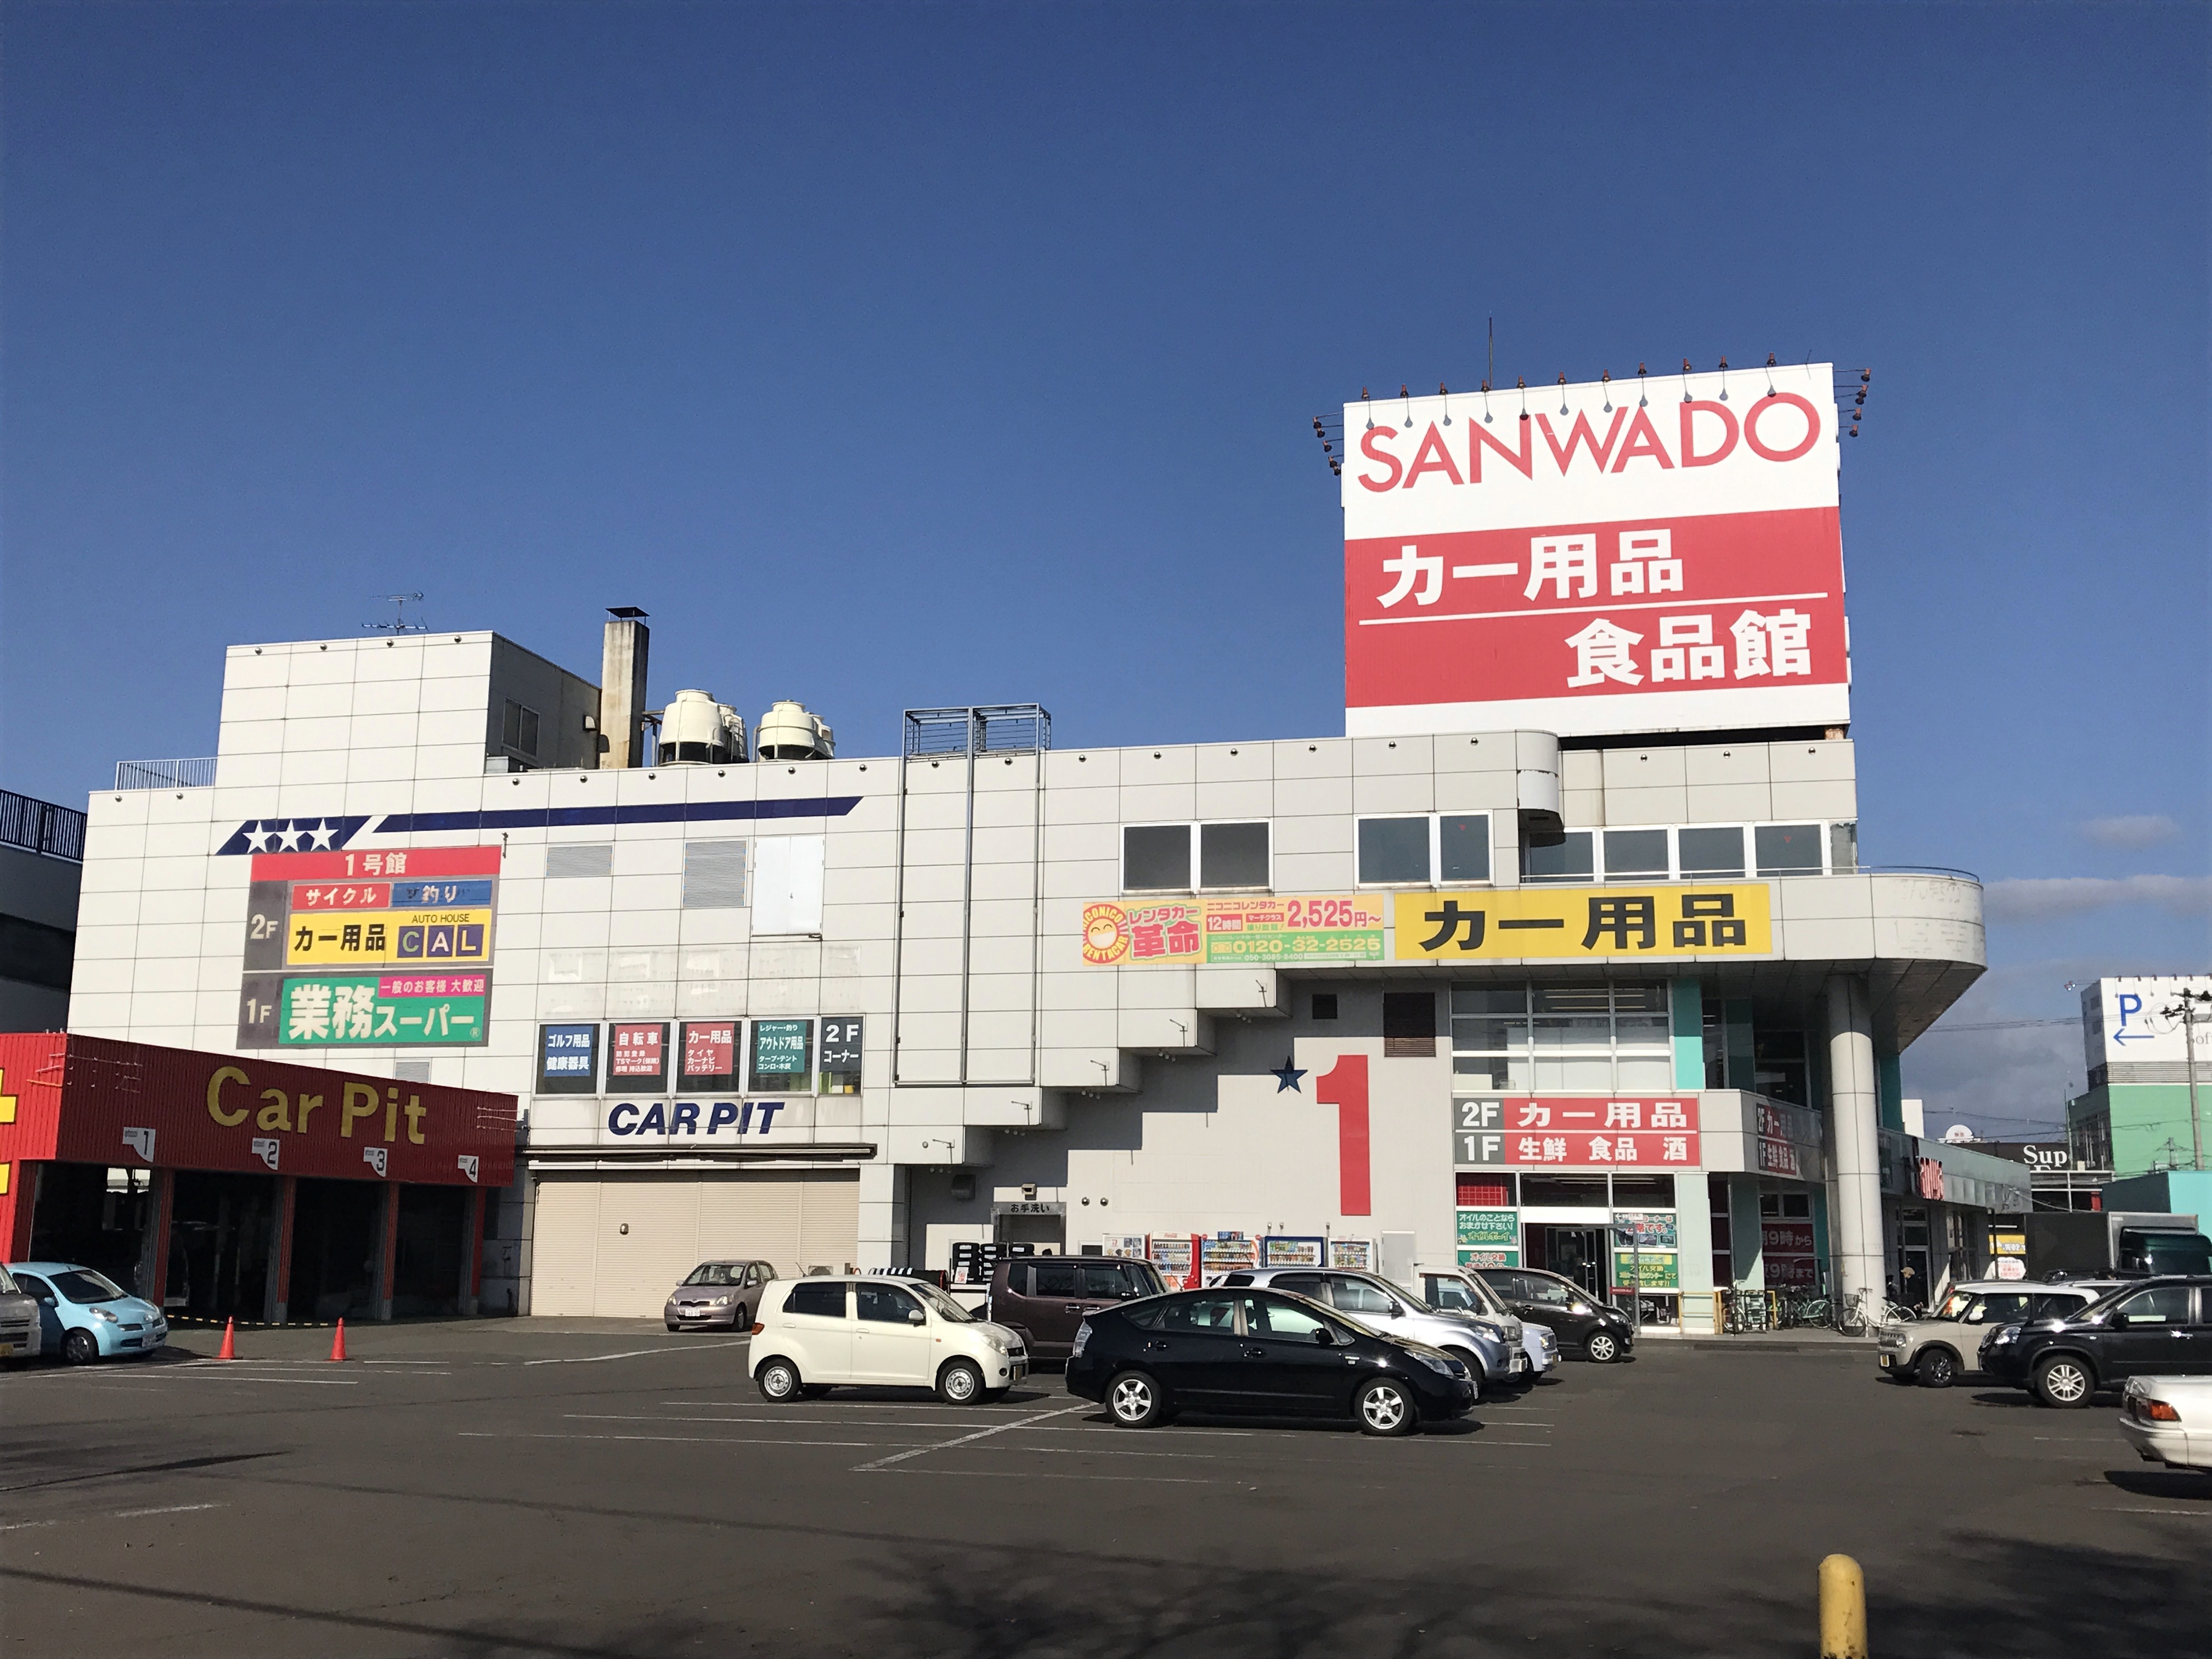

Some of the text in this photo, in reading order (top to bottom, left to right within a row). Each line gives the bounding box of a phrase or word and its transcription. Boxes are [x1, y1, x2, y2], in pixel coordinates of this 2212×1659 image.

[1357, 391, 1820, 493] SANWADO
[1376, 528, 1684, 608] カー用品
[1564, 607, 1812, 689] 食品館
[345, 852, 407, 876] 1号館
[306, 887, 377, 906] サイクル
[1207, 900, 1284, 911] ニコニコレンタカー
[411, 913, 470, 924] AUTO HOUSE
[1128, 906, 1198, 924] レンタカー
[1207, 916, 1242, 931] 12時間
[1418, 893, 1746, 952] カー用品
[250, 914, 278, 940] 2F
[294, 923, 386, 952] カー用品
[402, 929, 476, 952] CAL
[1083, 935, 1128, 961] RENTACAR
[1131, 921, 1199, 957] 革命
[1233, 938, 1381, 953] 0120-32-2525
[380, 979, 484, 994] 一般のお客様 大歓迎
[246, 998, 272, 1024] 1F
[287, 983, 475, 1041] 業務スーパー
[2119, 994, 2142, 1026] P
[548, 1034, 590, 1048] ゴルフ用品
[619, 1031, 658, 1046] 自転車
[688, 1029, 732, 1045] カー用品
[759, 1036, 804, 1051] アウトドア用品
[825, 1024, 859, 1043] 2F
[546, 1056, 589, 1071] 健康器具
[687, 1048, 714, 1057] タイヤ
[823, 1048, 859, 1063] コーナー
[686, 1064, 723, 1072] バッテリー
[206, 1065, 427, 1146] Car Pit
[1461, 1102, 1688, 1129] 2F カー用品
[608, 1101, 785, 1136] CAR PIT
[144, 1131, 149, 1155] 1
[1316, 1054, 1371, 1216] 1
[267, 1141, 278, 1165] 2
[1463, 1135, 1688, 1163] 1F 生鮮 食品 酒
[376, 1150, 385, 1172] 3
[469, 1158, 477, 1177] 4
[1011, 1203, 1049, 1213] お手洗い
[1459, 1213, 1515, 1222] オイルのことなら
